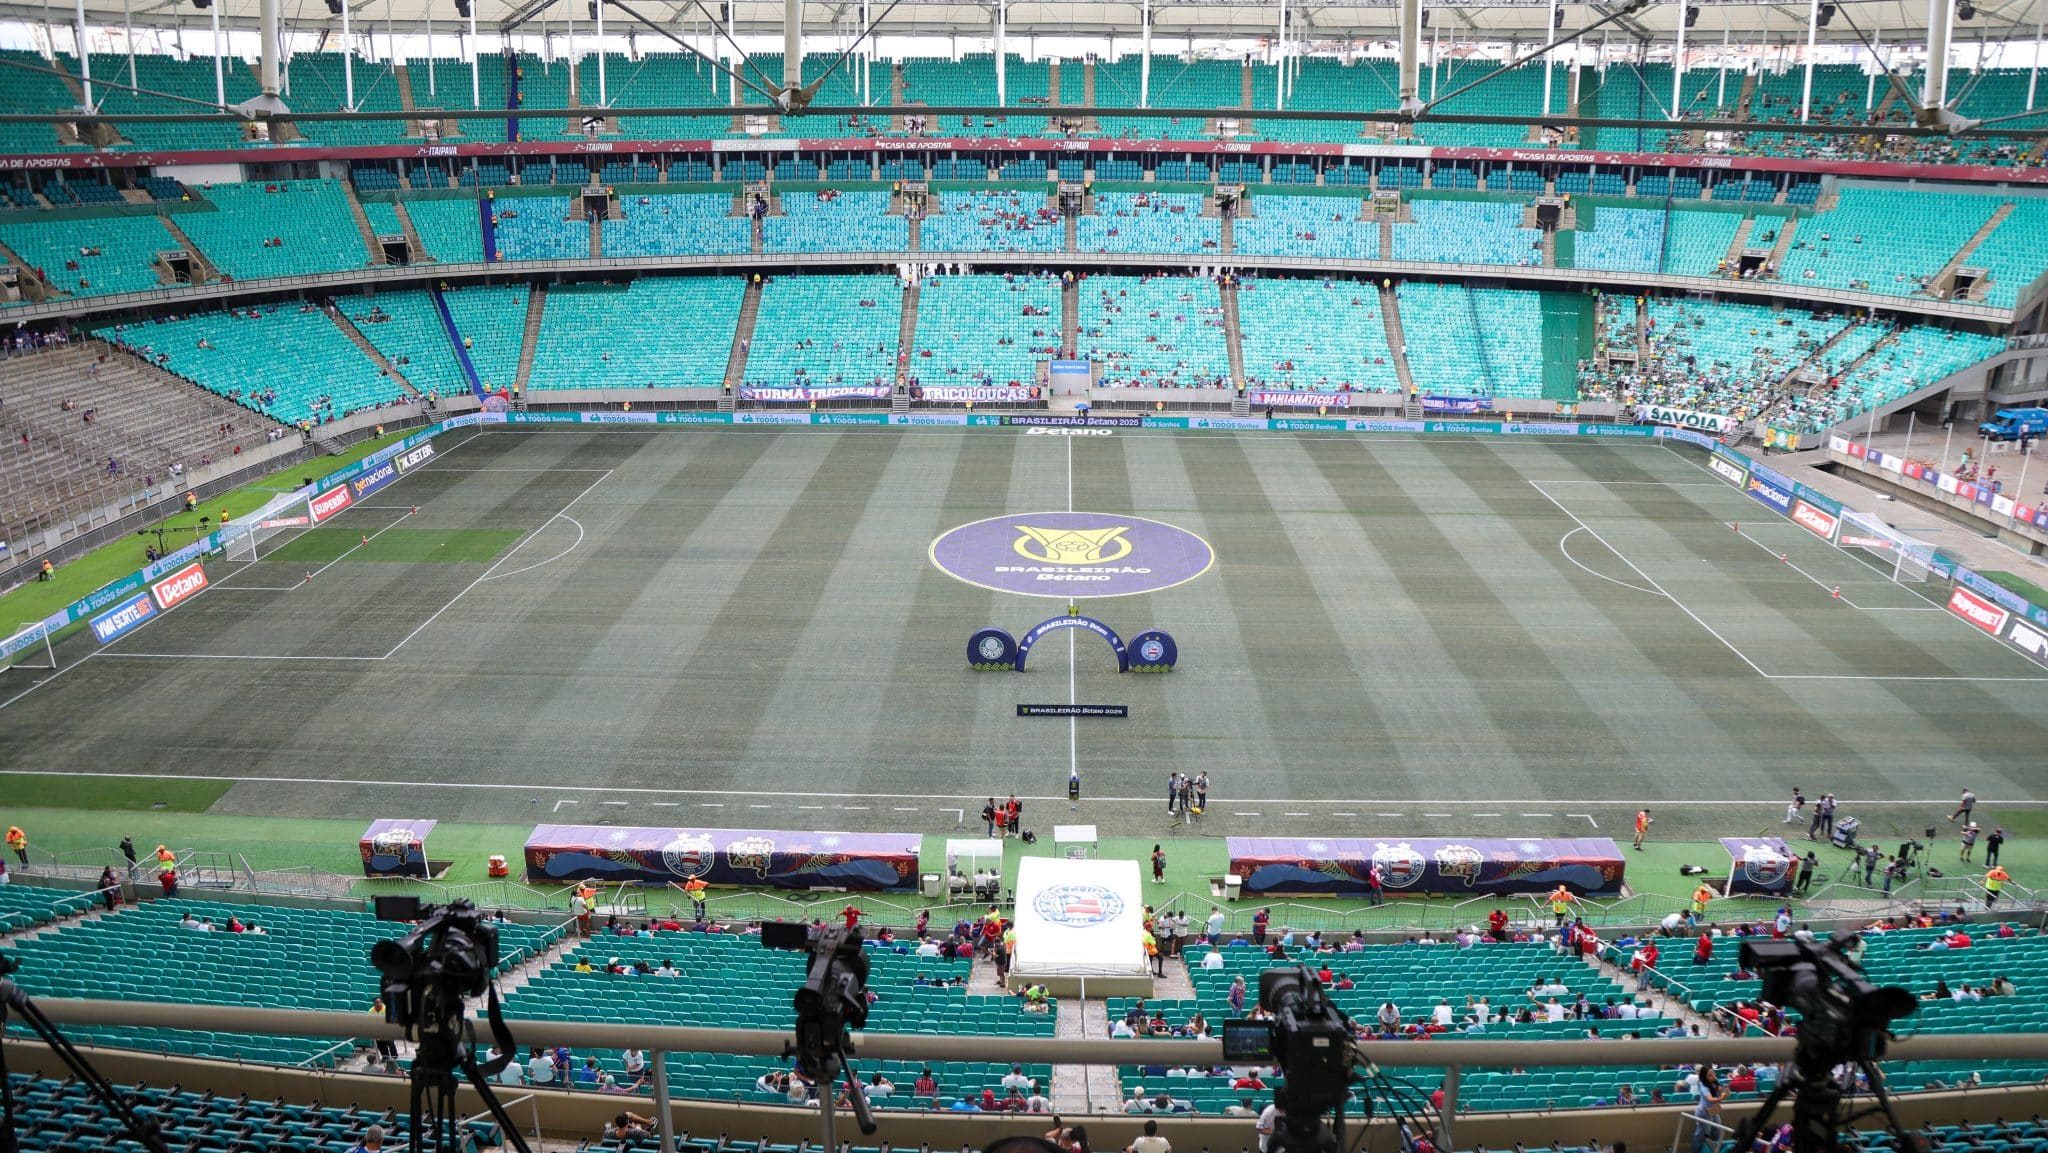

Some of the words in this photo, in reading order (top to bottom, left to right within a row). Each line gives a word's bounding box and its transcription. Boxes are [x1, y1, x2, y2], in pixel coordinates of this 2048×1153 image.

[428, 146, 458, 155] ITAIPAVA
[586, 142, 613, 152] ITAIPAVA
[1063, 141, 1089, 150] ITAIPAVA
[1225, 143, 1252, 152] ITAIPAVA
[11, 159, 24, 168] DE
[25, 158, 71, 167] APOSTAS
[1558, 154, 1595, 162] APOSTAS
[1701, 157, 1732, 167] ITAIPAVA
[751, 388, 805, 400] TURMA
[808, 387, 874, 400] TRICOLOR
[922, 387, 1029, 401] TRICOLOUCAS
[527, 415, 550, 423] TODOS
[678, 415, 701, 423] TODOS
[755, 416, 779, 424] TODOS
[1011, 416, 1085, 425] BRASILEIRÃO
[1087, 417, 1118, 426] Betano
[1650, 408, 1718, 430] SAVÓIA
[1290, 422, 1315, 430] TODOS
[1368, 423, 1393, 431] TODOS
[1026, 427, 1113, 436] Betano
[354, 462, 394, 494] betnacional
[1750, 476, 1790, 508] betnacional
[314, 487, 349, 515] SUPERBET
[163, 556, 185, 571] TODOS
[995, 566, 1152, 574] BRASILEIRÃO
[1036, 573, 1111, 581] Betano
[161, 571, 203, 604] Betano
[91, 594, 114, 610] TODOS
[116, 581, 138, 597] Sonhos
[1036, 618, 1088, 635] BRASILEIRÃO
[6, 633, 35, 653] TODOS
